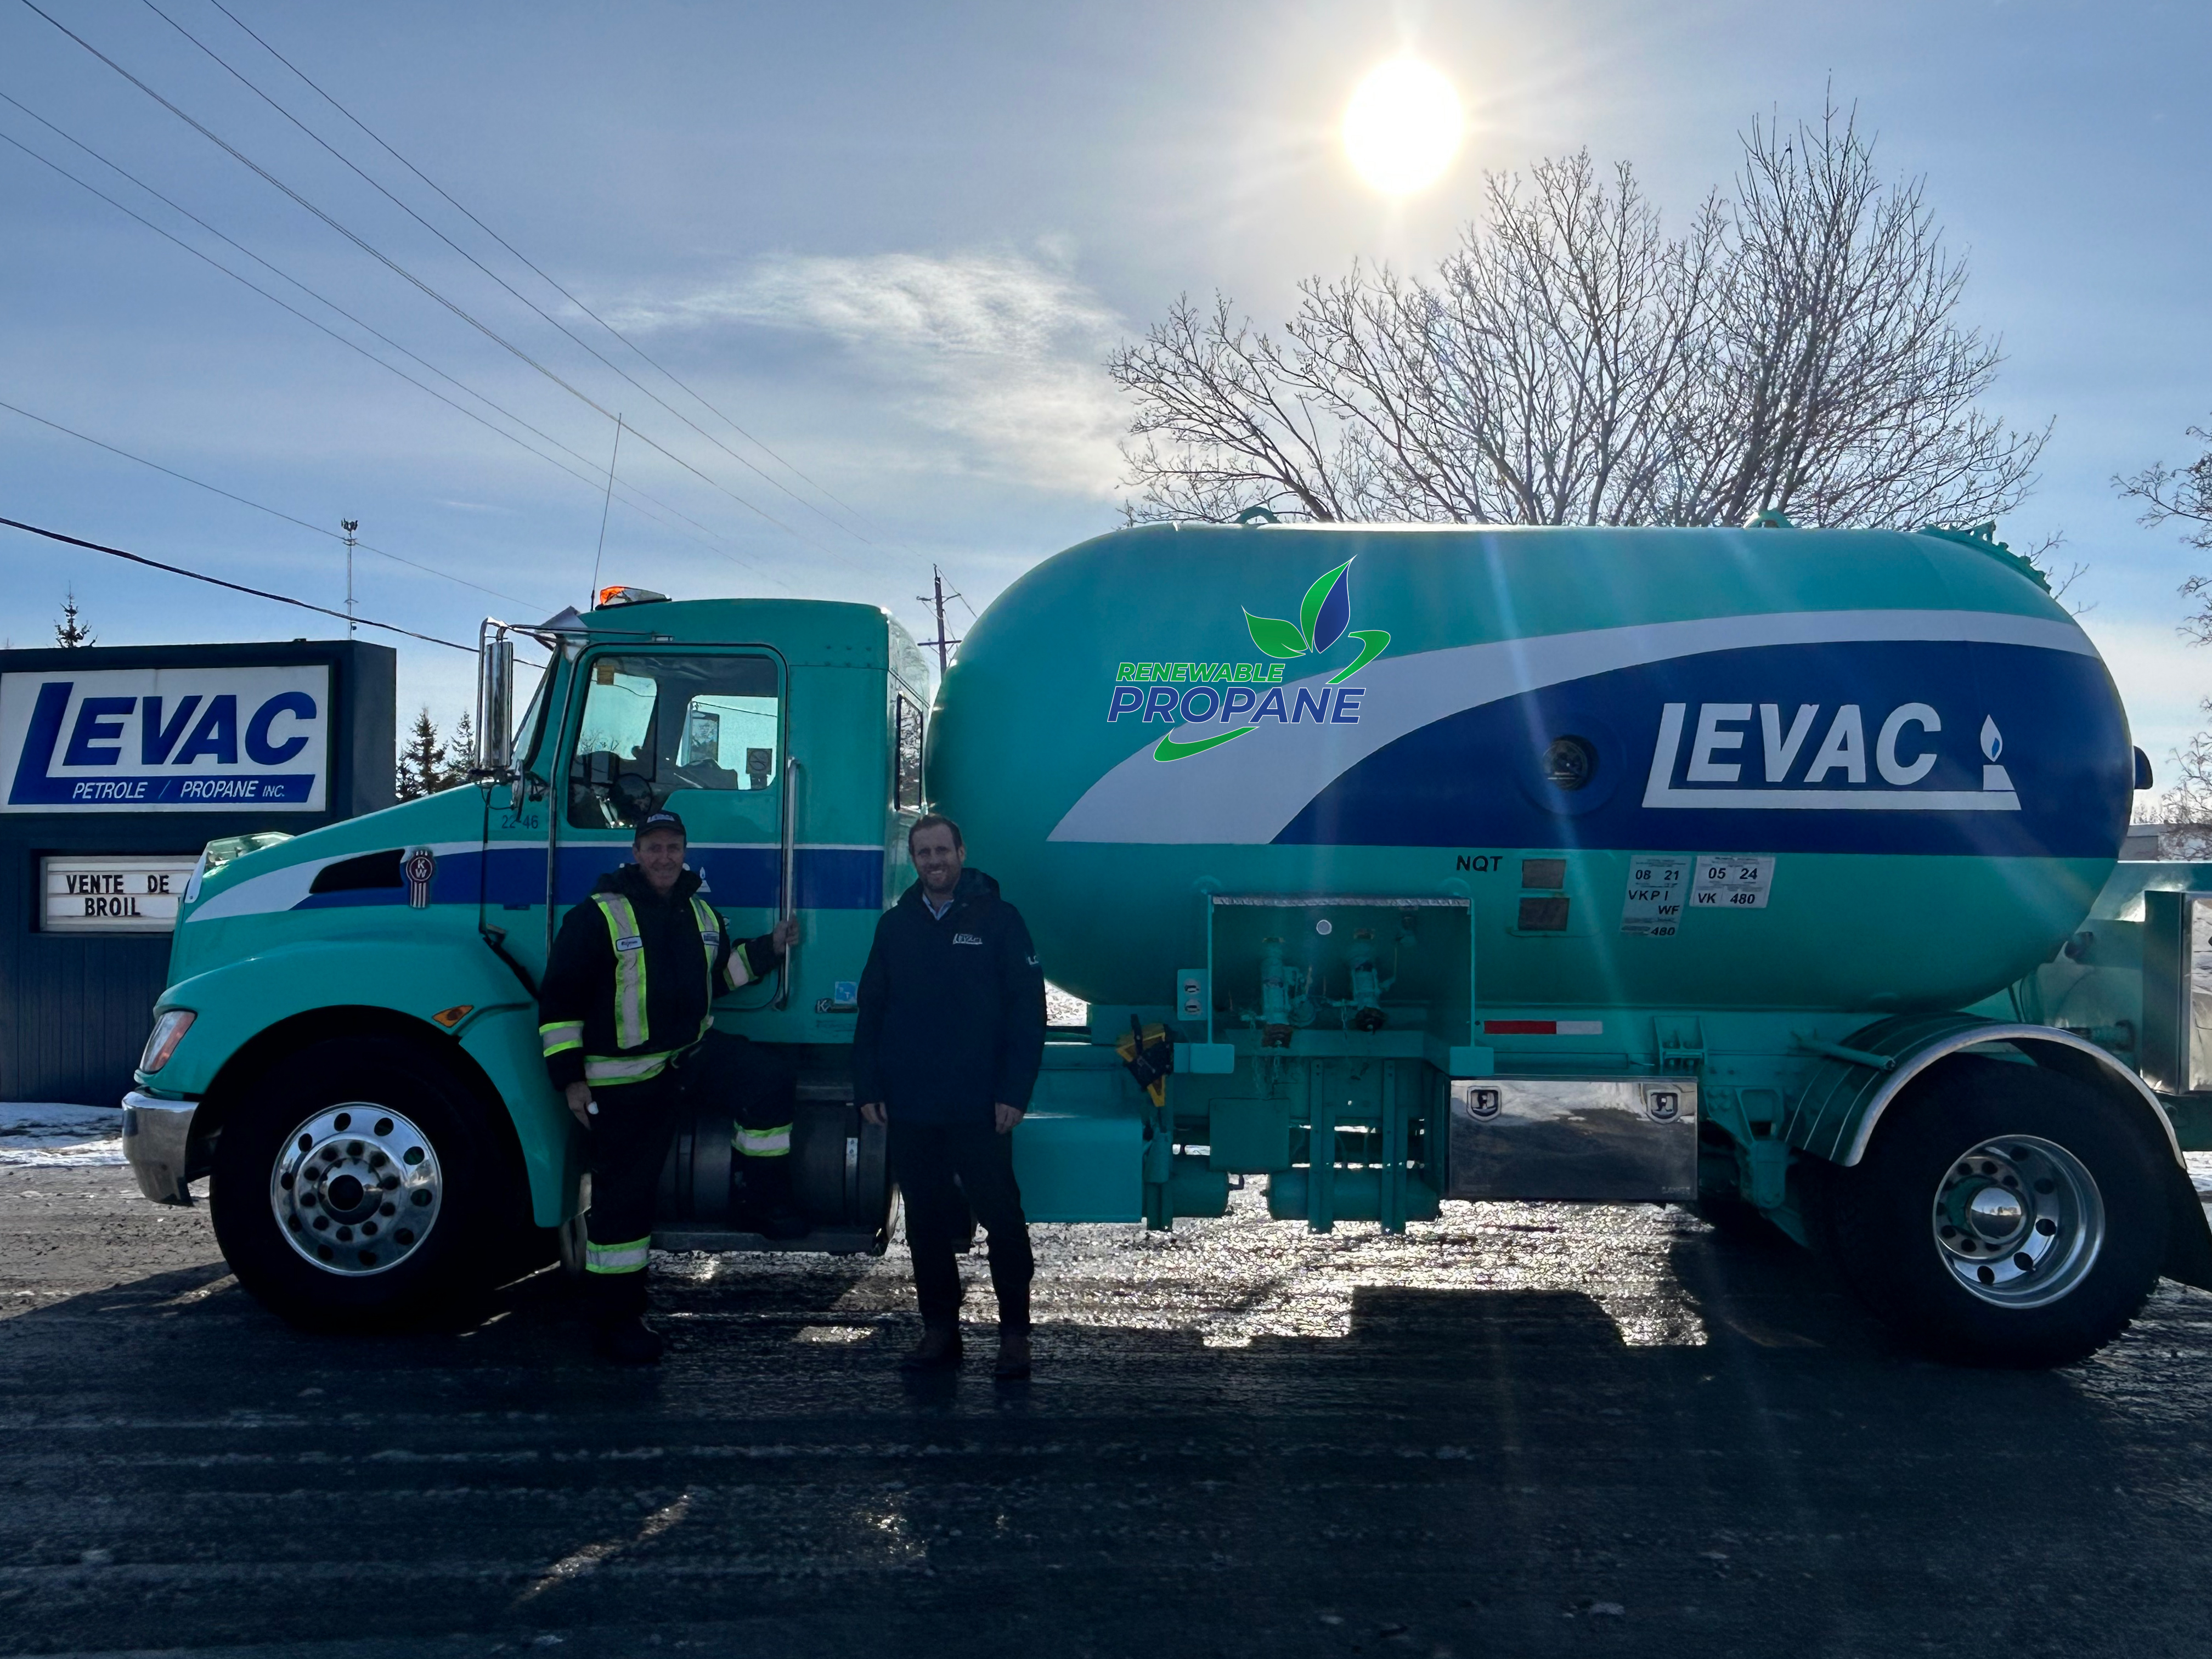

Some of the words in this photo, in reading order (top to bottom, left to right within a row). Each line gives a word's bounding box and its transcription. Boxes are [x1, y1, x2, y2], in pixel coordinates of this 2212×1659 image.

[1116, 662, 1285, 682] RENEWABLE
[1107, 686, 1366, 724] PROPANE
[8, 682, 317, 805] LEVAC
[1642, 703, 2021, 810] LEVAC
[72, 782, 148, 800] PETROLE
[180, 780, 259, 798] PROPANE
[262, 785, 285, 797] INC.
[1456, 855, 1503, 872] NQT
[1635, 870, 1651, 880] 08
[1664, 870, 1679, 881] 21
[1708, 867, 1726, 879] 05
[1740, 868, 1758, 880] 24
[66, 874, 124, 894] VENTE
[148, 874, 170, 894] DE
[84, 897, 140, 916] BROIL
[1699, 893, 1717, 904] VK
[1730, 893, 1756, 904] 480
[1658, 905, 1680, 915] WF
[1651, 927, 1675, 936] 480
